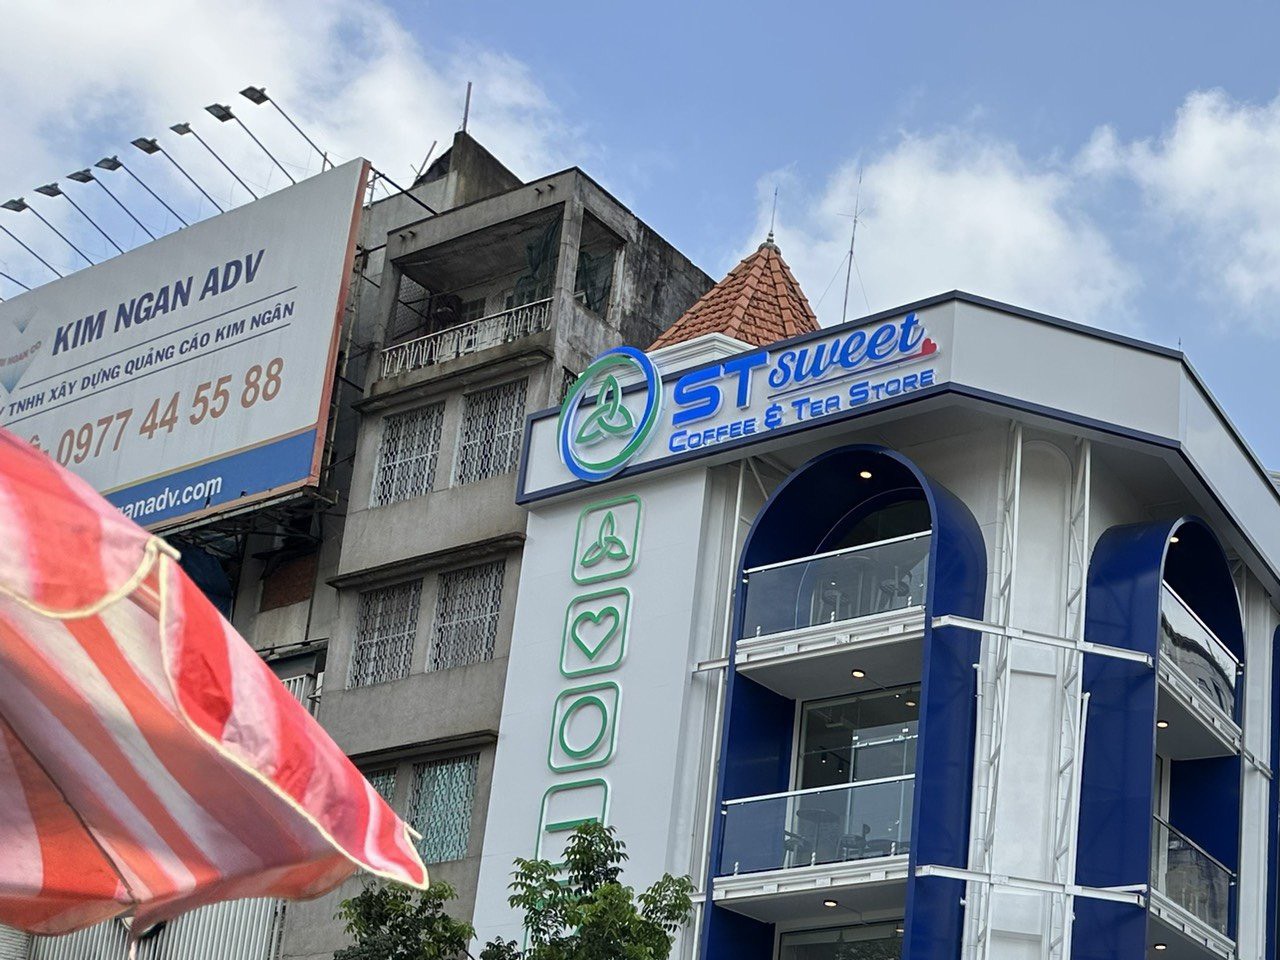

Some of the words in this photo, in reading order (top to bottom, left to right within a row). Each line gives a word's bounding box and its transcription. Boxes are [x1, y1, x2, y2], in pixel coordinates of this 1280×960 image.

[52, 309, 107, 356] KIM
[113, 276, 194, 333] NGAN
[200, 249, 265, 301] ADV
[9, 392, 45, 416] TNHH
[48, 380, 77, 402] XÂY
[81, 365, 121, 391] DỰNG
[124, 347, 175, 374] QUẢNG
[179, 332, 210, 355] CÁO
[215, 320, 246, 343] KIM
[250, 302, 295, 330] NGÂN
[56, 408, 133, 467] 0977
[139, 391, 180, 440] 44
[189, 374, 233, 425] 55
[240, 357, 284, 409] 88
[764, 402, 783, 430] &
